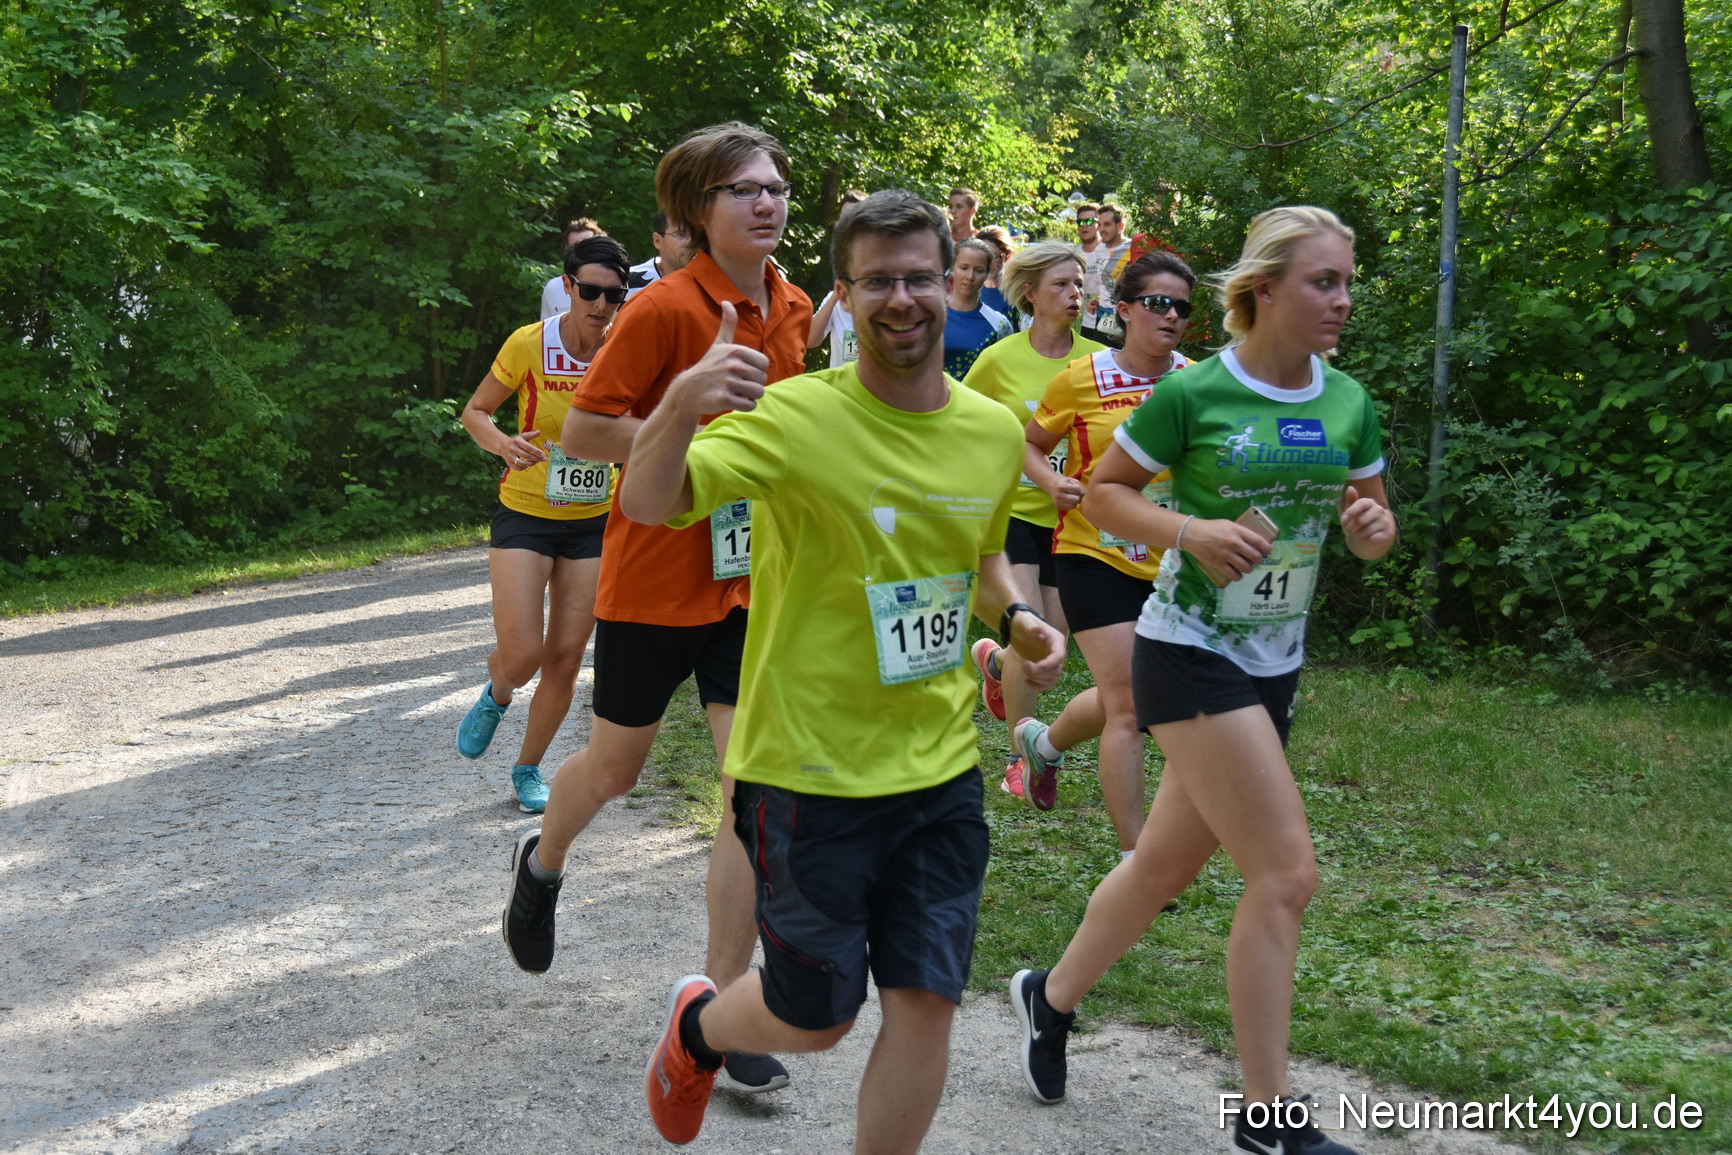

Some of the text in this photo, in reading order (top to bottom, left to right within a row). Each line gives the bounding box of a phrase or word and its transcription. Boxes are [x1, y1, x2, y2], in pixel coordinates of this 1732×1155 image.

[1103, 318, 1118, 329] 619
[1712, 323, 1727, 335] 39
[557, 467, 604, 488] 1680
[1218, 481, 1288, 498] Gesunde
[1301, 494, 1339, 506] länge
[1253, 571, 1289, 600] 41
[891, 609, 959, 654] 1195
[908, 654, 925, 663] Auer
